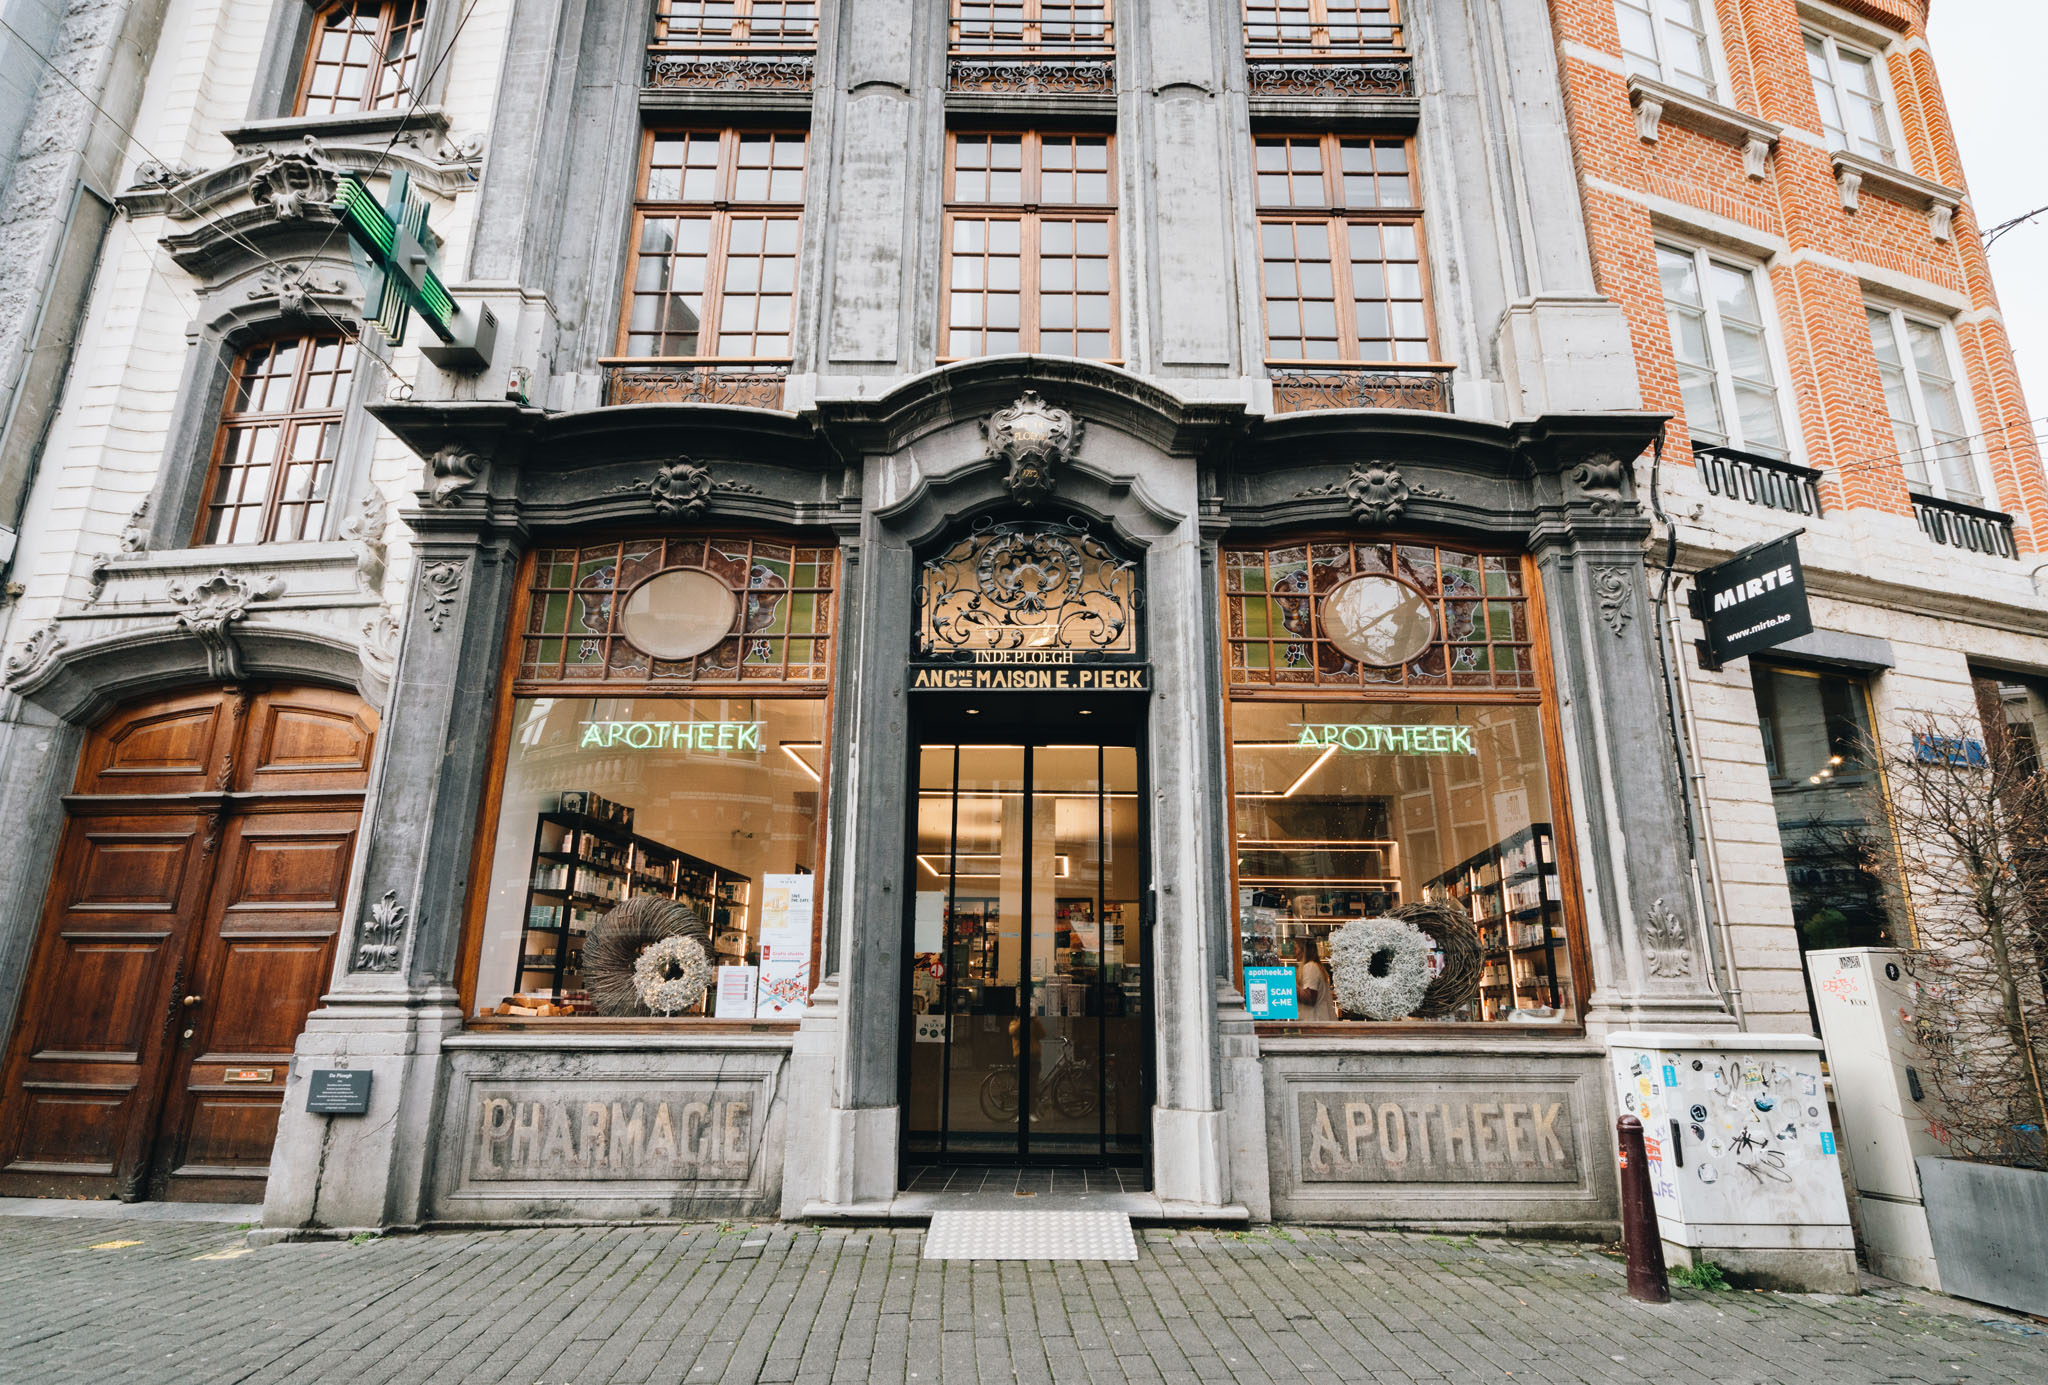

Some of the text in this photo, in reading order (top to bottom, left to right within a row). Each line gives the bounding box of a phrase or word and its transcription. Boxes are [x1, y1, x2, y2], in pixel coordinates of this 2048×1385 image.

[1714, 564, 1794, 612] MIRTE
[1726, 613, 1791, 642] www.mirte.be
[1014, 651, 1073, 664] PLOEGH
[976, 670, 1051, 688] MAISON
[581, 723, 758, 750] APOTHEEK
[1299, 725, 1472, 752] APOTHEEK
[1248, 969, 1292, 977] apotheek.be
[1271, 988, 1292, 996] SCAN
[482, 1098, 749, 1168] PHARMACIE
[1308, 1098, 1566, 1173] APOTHEEK
